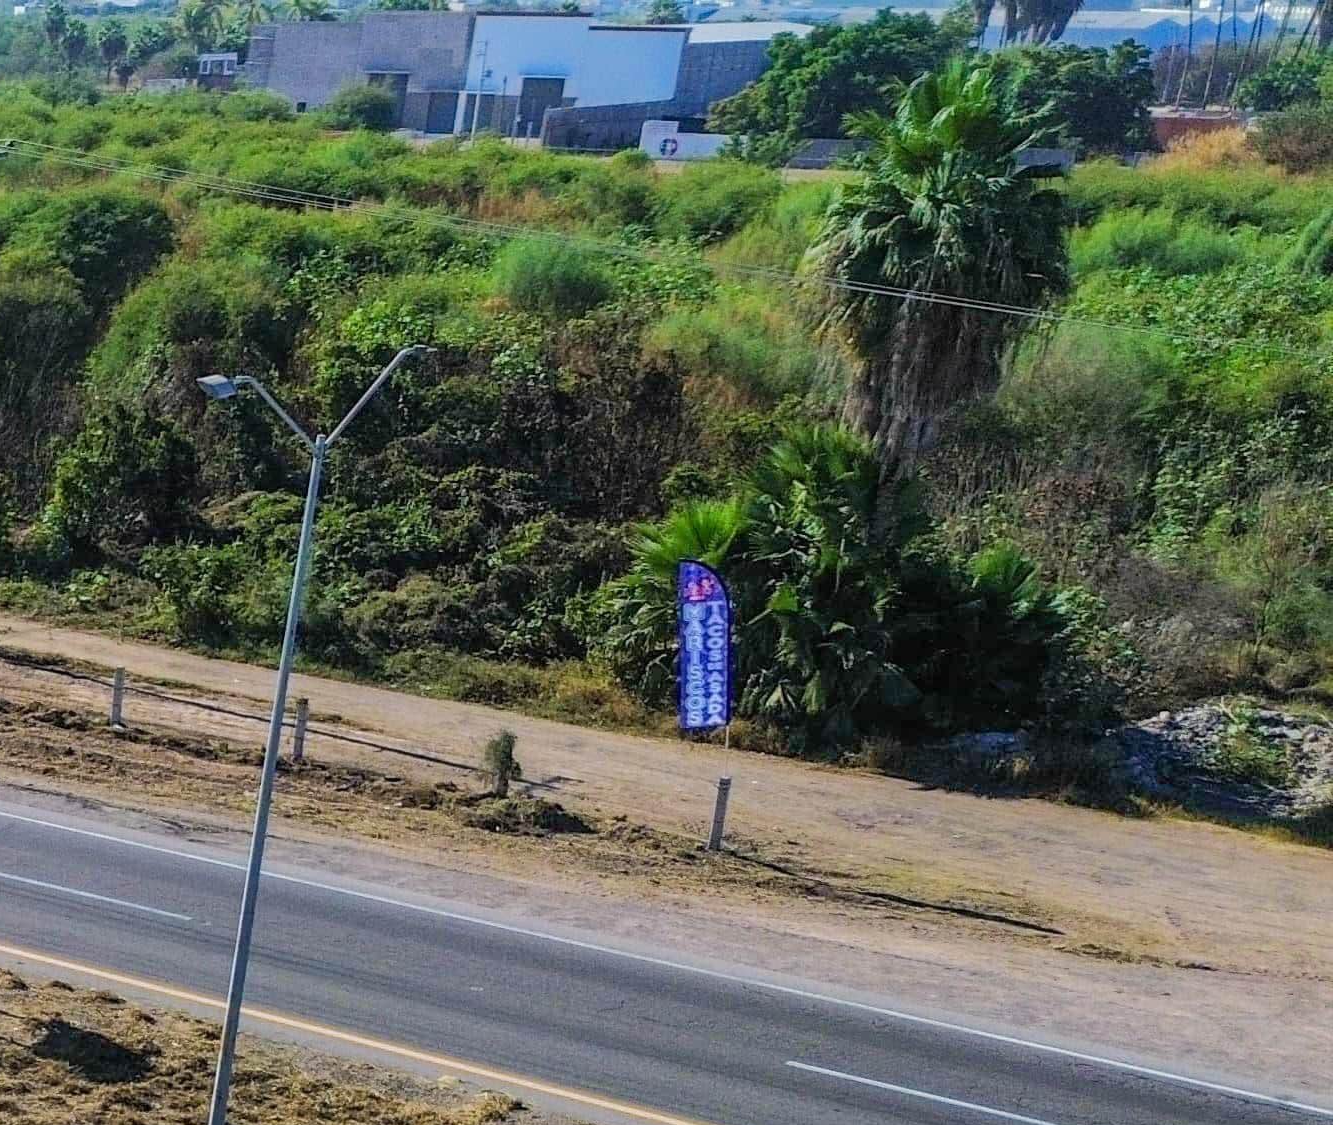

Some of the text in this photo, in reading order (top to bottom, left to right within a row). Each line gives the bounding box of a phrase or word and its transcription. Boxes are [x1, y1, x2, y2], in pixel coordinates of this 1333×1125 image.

[707, 600, 725, 661] TACOS
[683, 603, 706, 727] MARISCOS
[707, 671, 725, 726] ASADA
